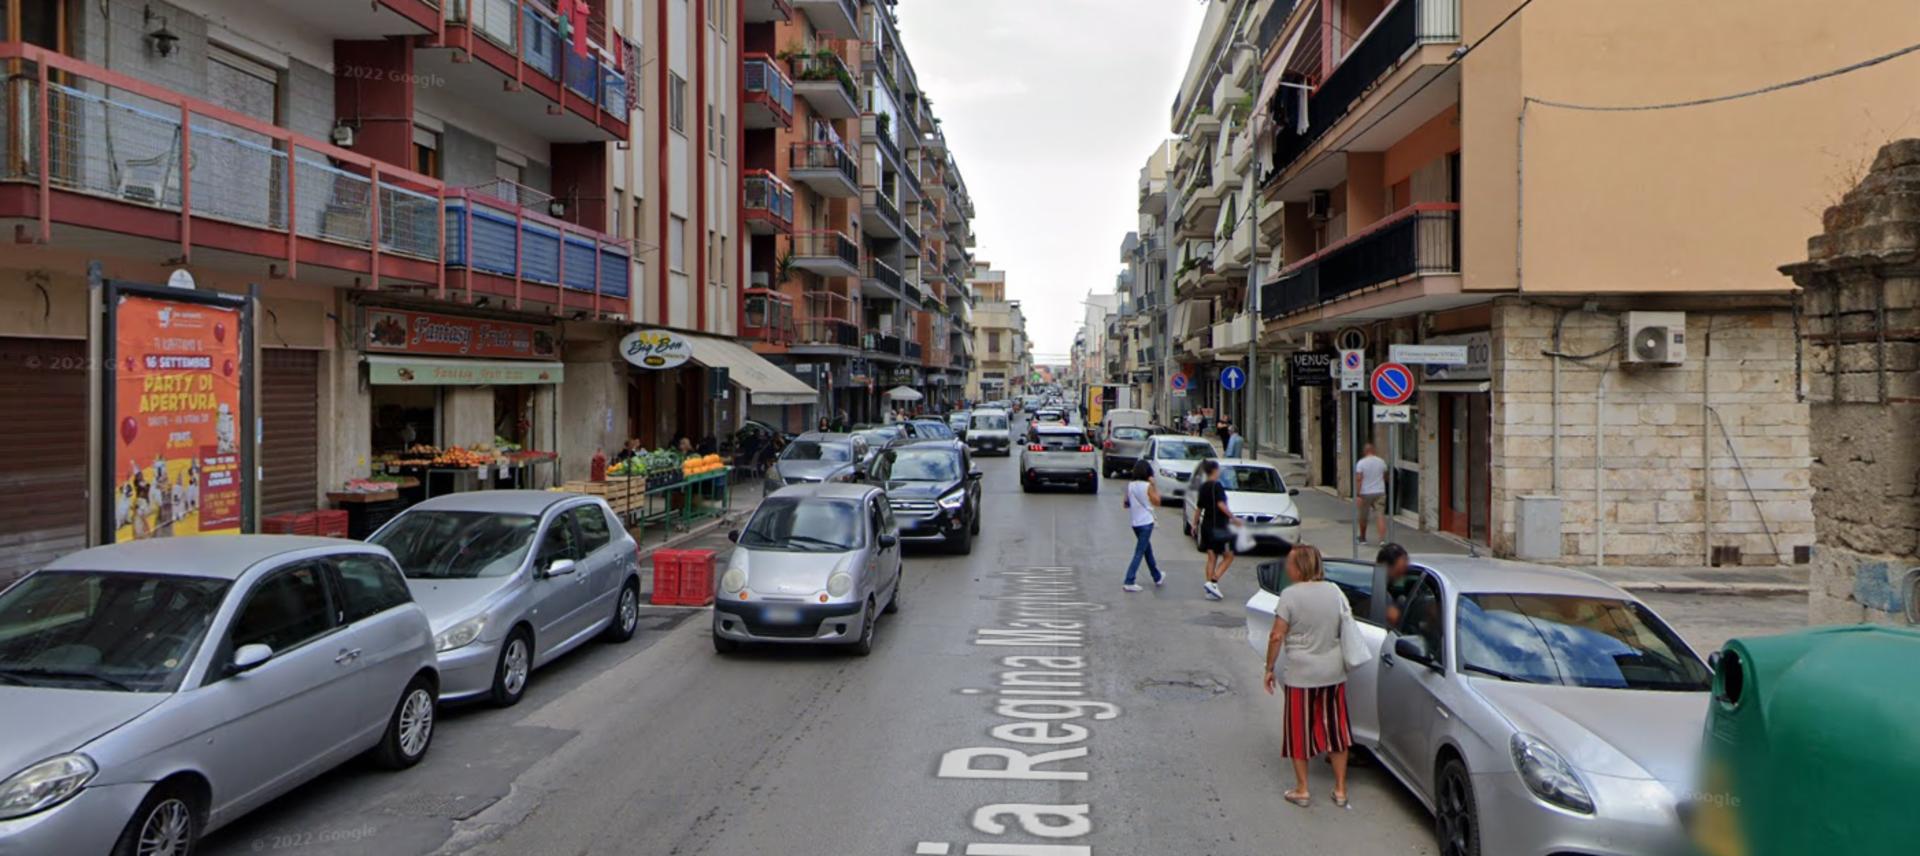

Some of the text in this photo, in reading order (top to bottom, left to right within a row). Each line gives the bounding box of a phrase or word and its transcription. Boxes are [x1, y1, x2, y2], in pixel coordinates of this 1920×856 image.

[412, 317, 473, 353] Fantasy
[628, 339, 653, 356] Big
[146, 355, 211, 369] 16 SETTEMBRE
[1293, 353, 1330, 367] VENUS
[144, 373, 213, 393] PARTY DI
[139, 393, 217, 413] APERTURA
